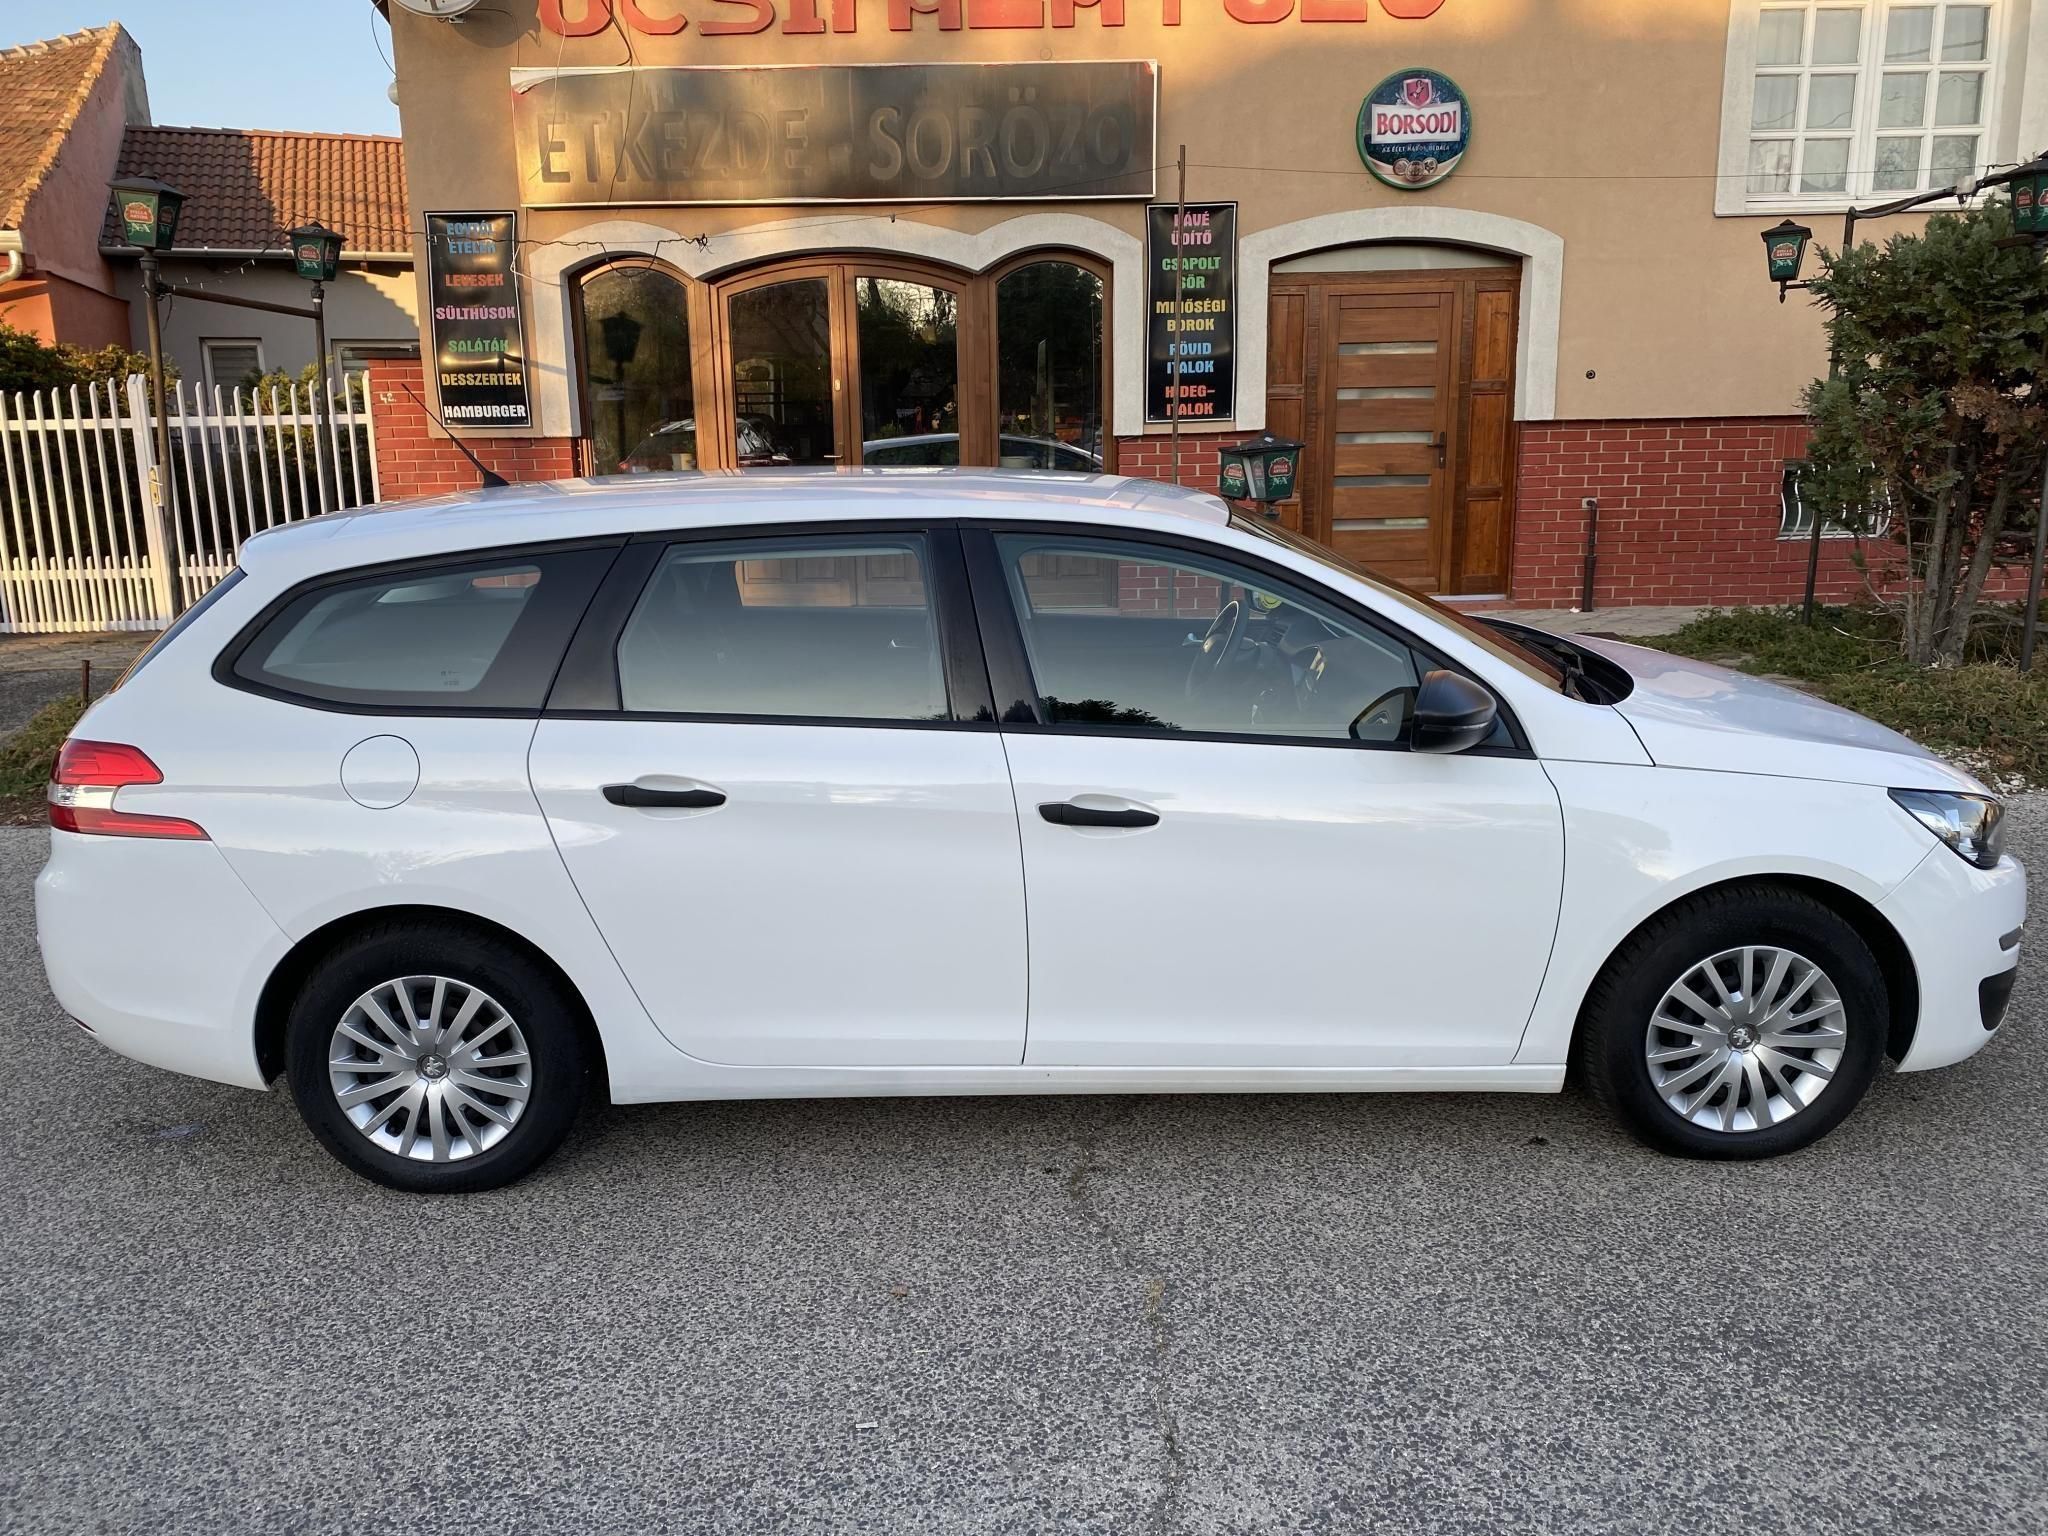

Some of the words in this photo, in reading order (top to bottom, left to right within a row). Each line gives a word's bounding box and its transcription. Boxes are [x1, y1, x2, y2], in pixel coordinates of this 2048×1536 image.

[1376, 110, 1457, 136] BORSODI
[1161, 256, 1221, 271] CSAPOLT
[445, 273, 504, 287] LEVESEK
[436, 304, 516, 320] SÜLTHÚSOK
[448, 337, 509, 353] SALÁTÁK
[441, 372, 522, 386] DESSZERTEK
[443, 404, 526, 418] HAMBURGER
